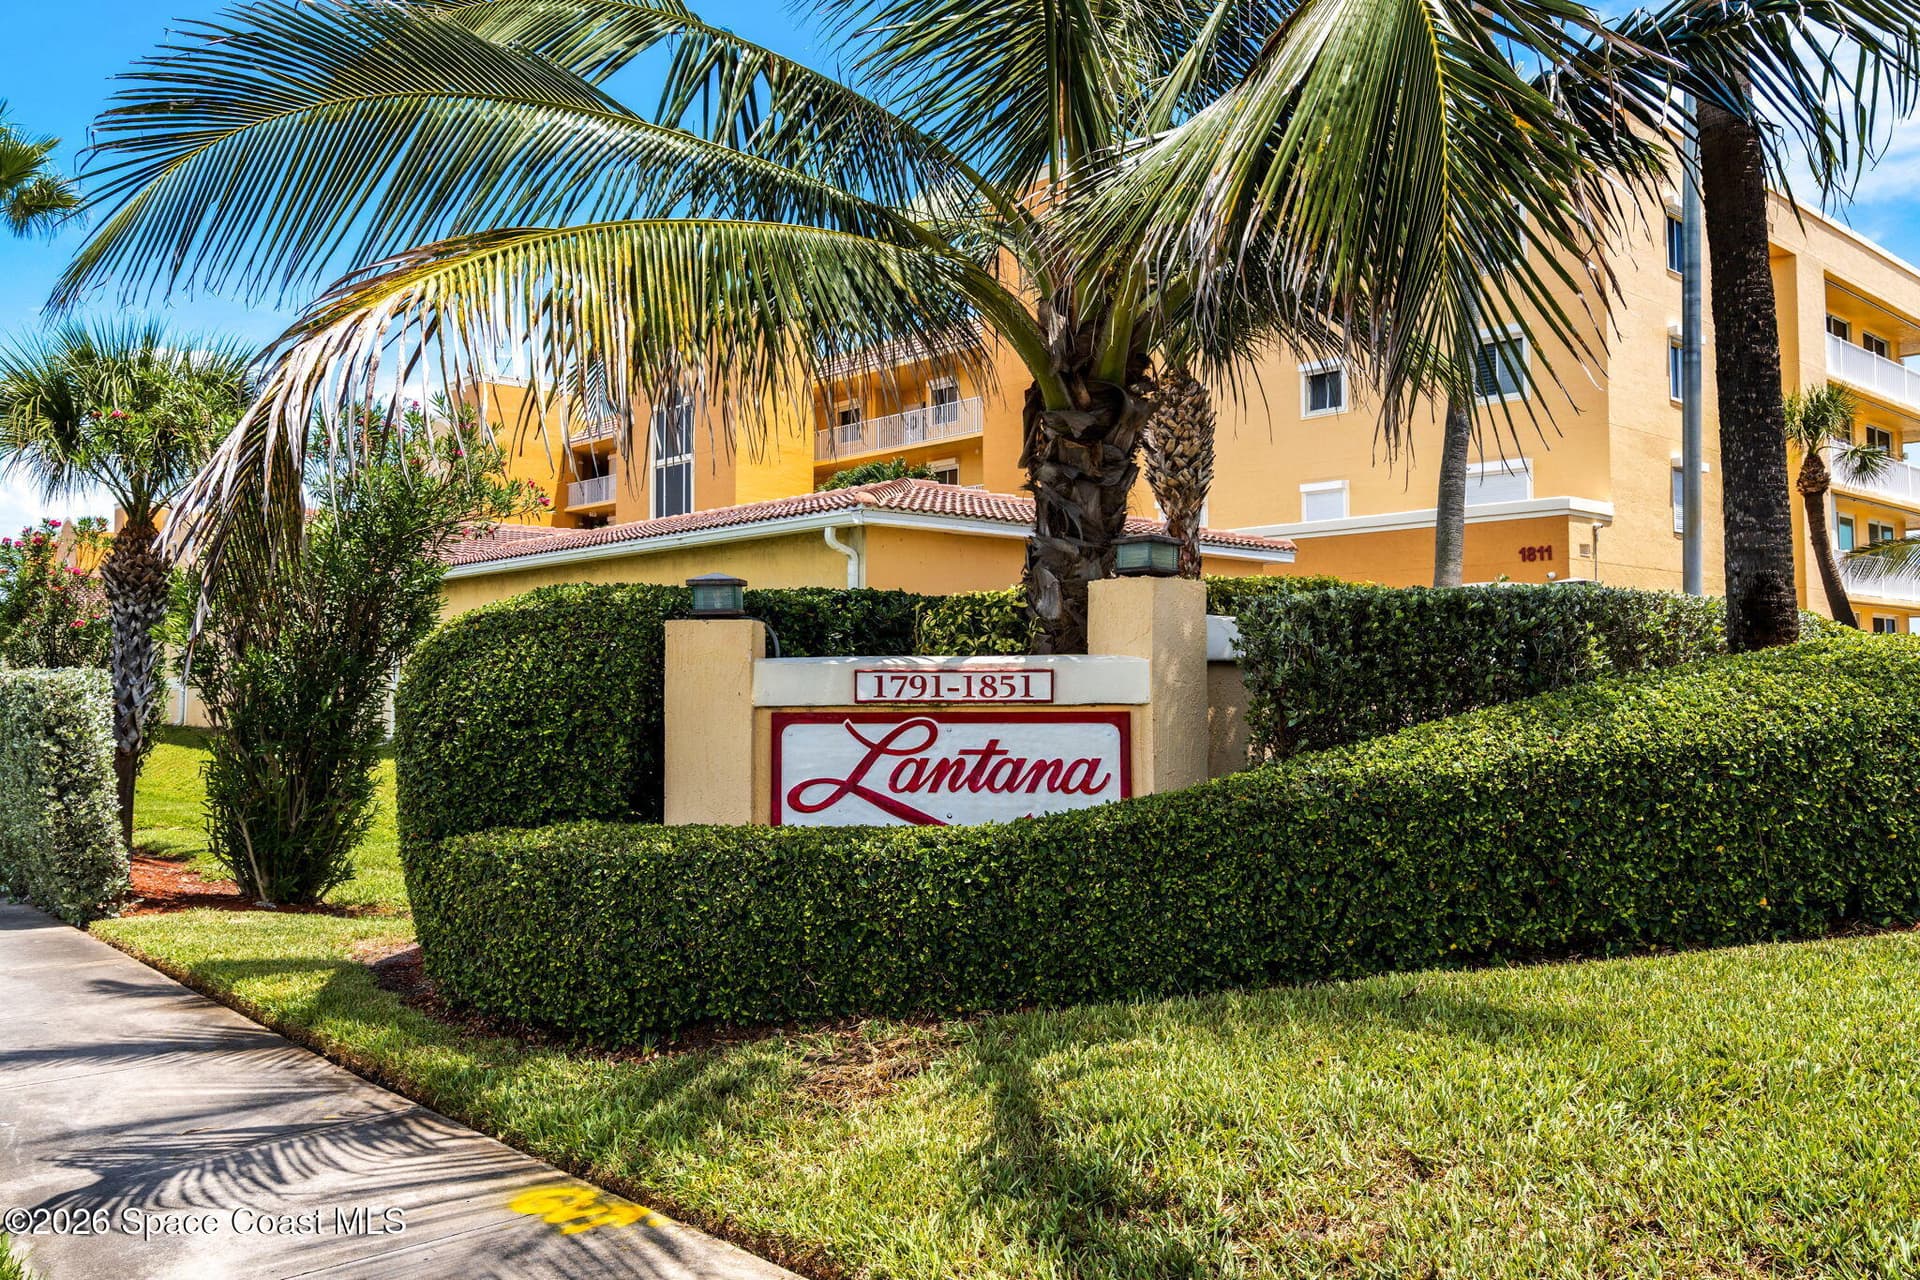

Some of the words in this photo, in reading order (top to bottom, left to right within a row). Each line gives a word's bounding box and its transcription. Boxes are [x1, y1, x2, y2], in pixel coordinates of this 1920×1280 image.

[1518, 545, 1553, 562] 1811
[873, 675, 1034, 698] 1791-1851
[787, 718, 1111, 826] Lantana
